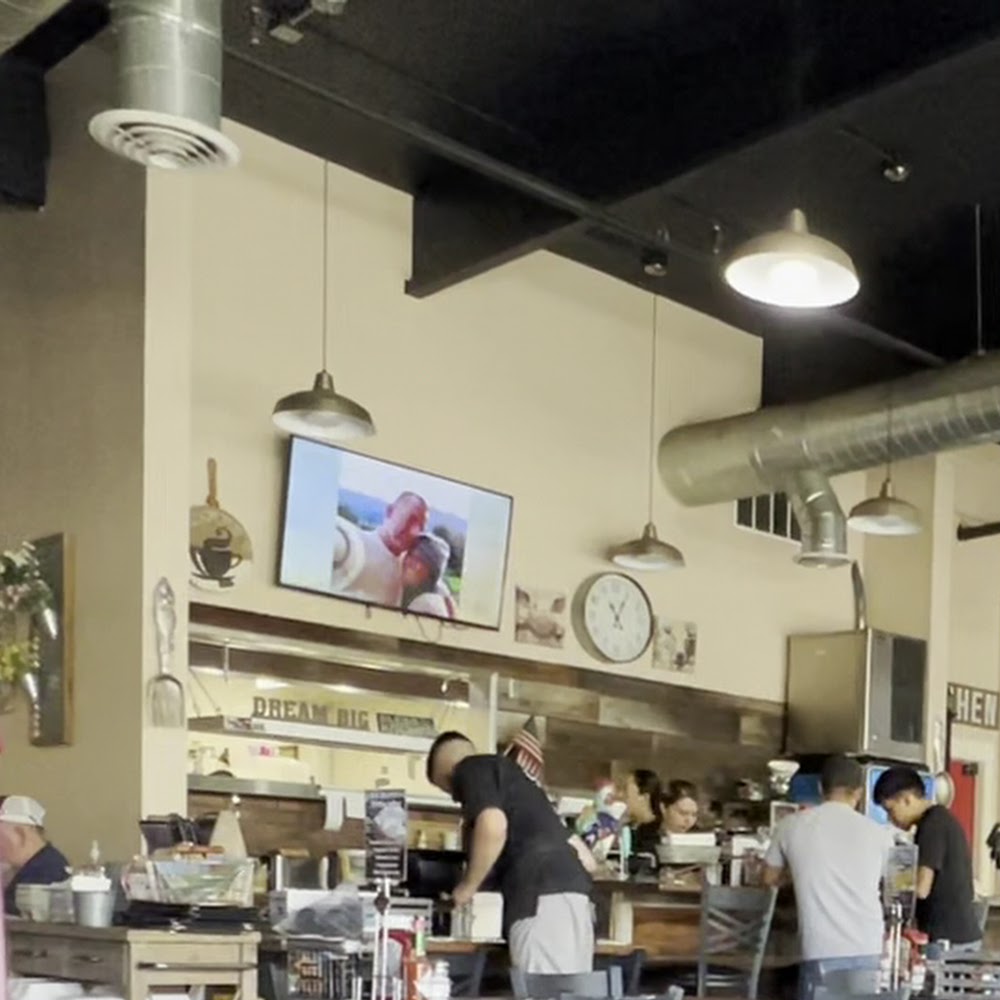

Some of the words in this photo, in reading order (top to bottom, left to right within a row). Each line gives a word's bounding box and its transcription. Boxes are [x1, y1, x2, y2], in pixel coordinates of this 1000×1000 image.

[252, 696, 329, 726] DREAM
[337, 708, 371, 731] BIG
[948, 685, 998, 727] HEN
